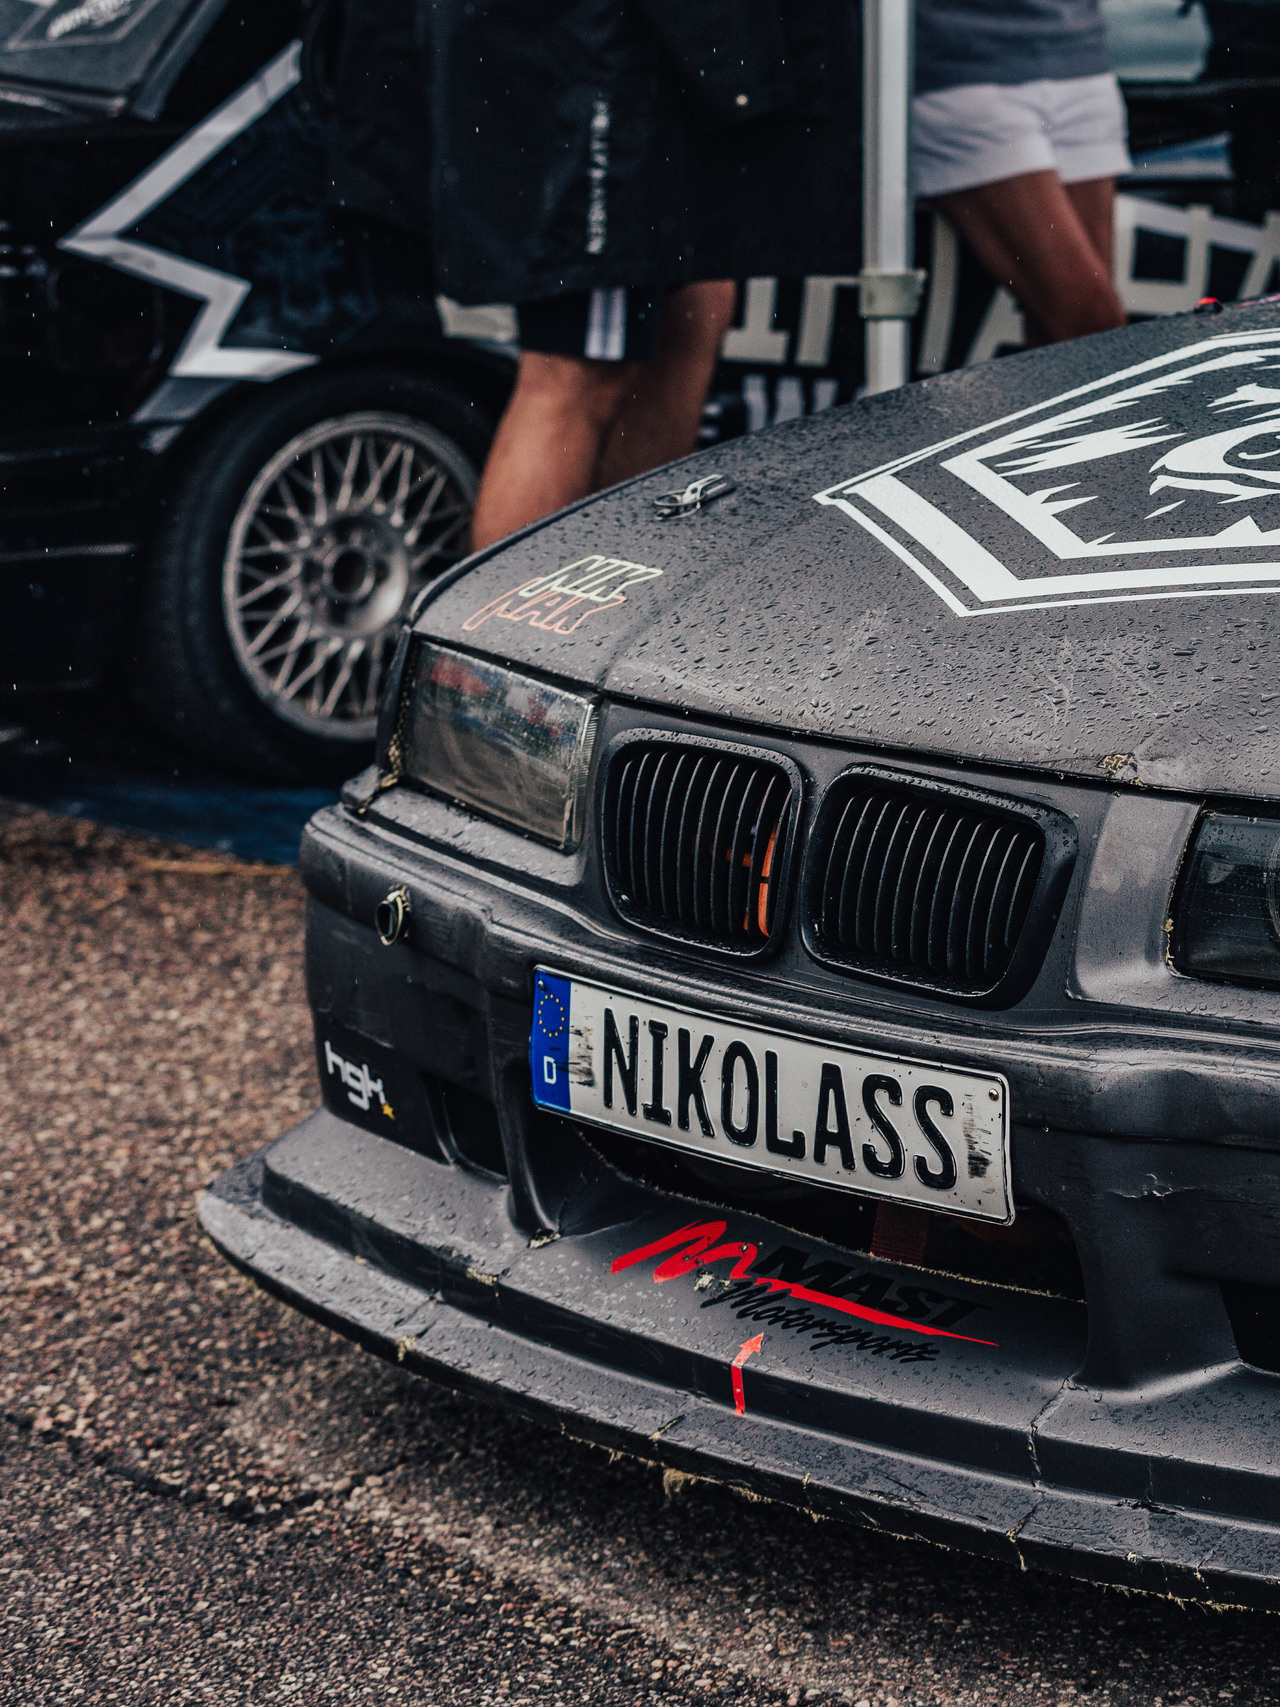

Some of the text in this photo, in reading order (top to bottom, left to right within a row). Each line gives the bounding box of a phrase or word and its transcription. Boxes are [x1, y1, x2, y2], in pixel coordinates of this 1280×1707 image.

[518, 555, 664, 602] NIK
[324, 1040, 386, 1111] hgk
[543, 1055, 557, 1085] D
[603, 1007, 957, 1190] NIKOLASS
[701, 1281, 941, 1363] Motorsports
[750, 1245, 994, 1328] MAST
